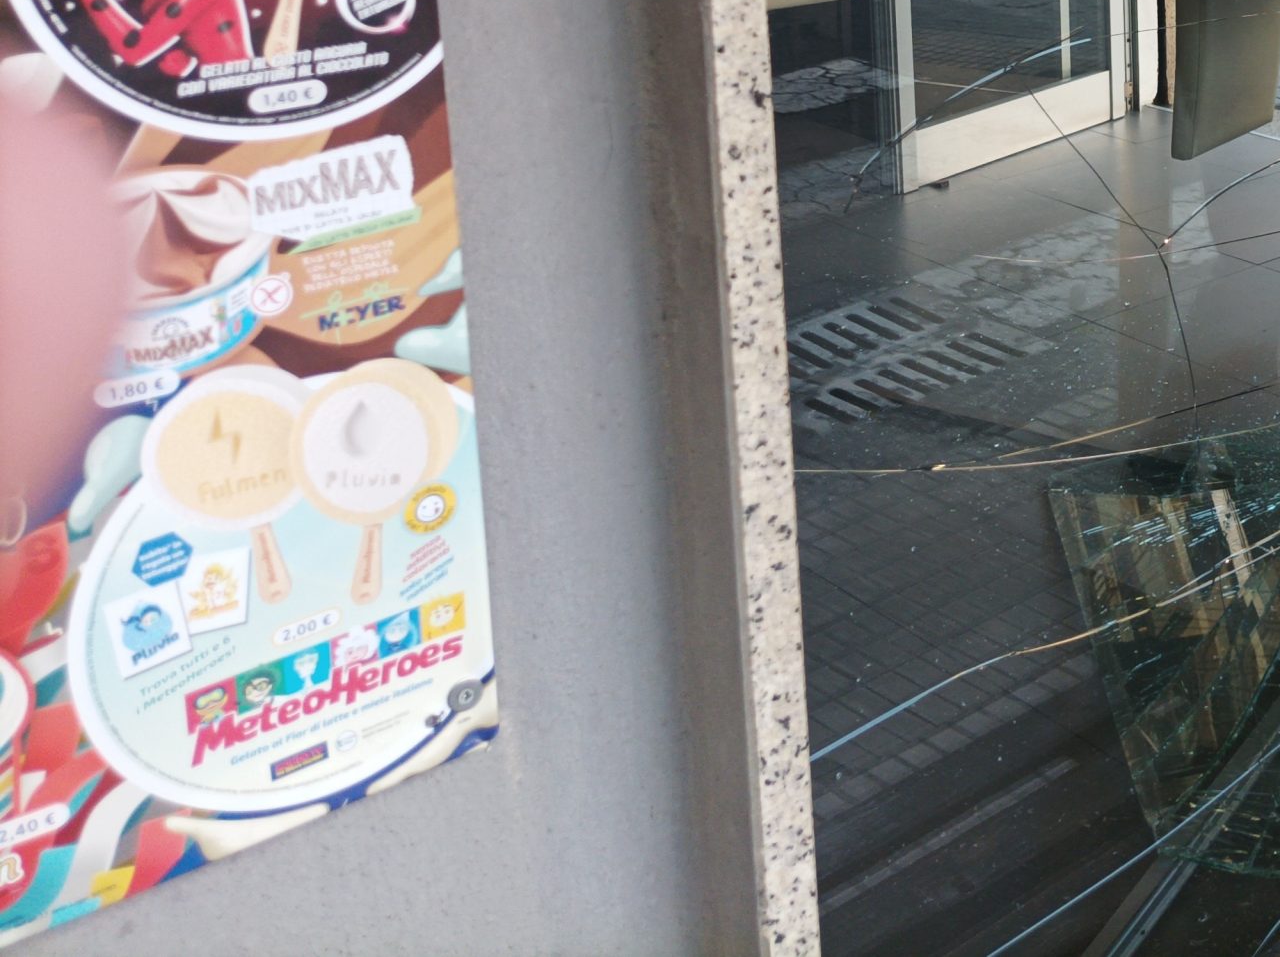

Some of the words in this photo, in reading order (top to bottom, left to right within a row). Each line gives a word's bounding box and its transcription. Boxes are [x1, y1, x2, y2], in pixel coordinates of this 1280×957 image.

[263, 88, 298, 107] 1,40
[304, 86, 314, 100] €
[255, 148, 400, 216] MIXMAX
[110, 380, 148, 401] 1,80
[154, 376, 165, 390] €
[325, 468, 402, 489] Pluvia
[282, 619, 318, 641] 2,00
[322, 613, 334, 627] €
[131, 631, 179, 666] Pluvia
[191, 634, 464, 768] MeteoHeroes
[230, 744, 270, 765] Gelato
[271, 737, 283, 748] al
[0, 819, 39, 844] 2,40
[45, 811, 57, 826] €
